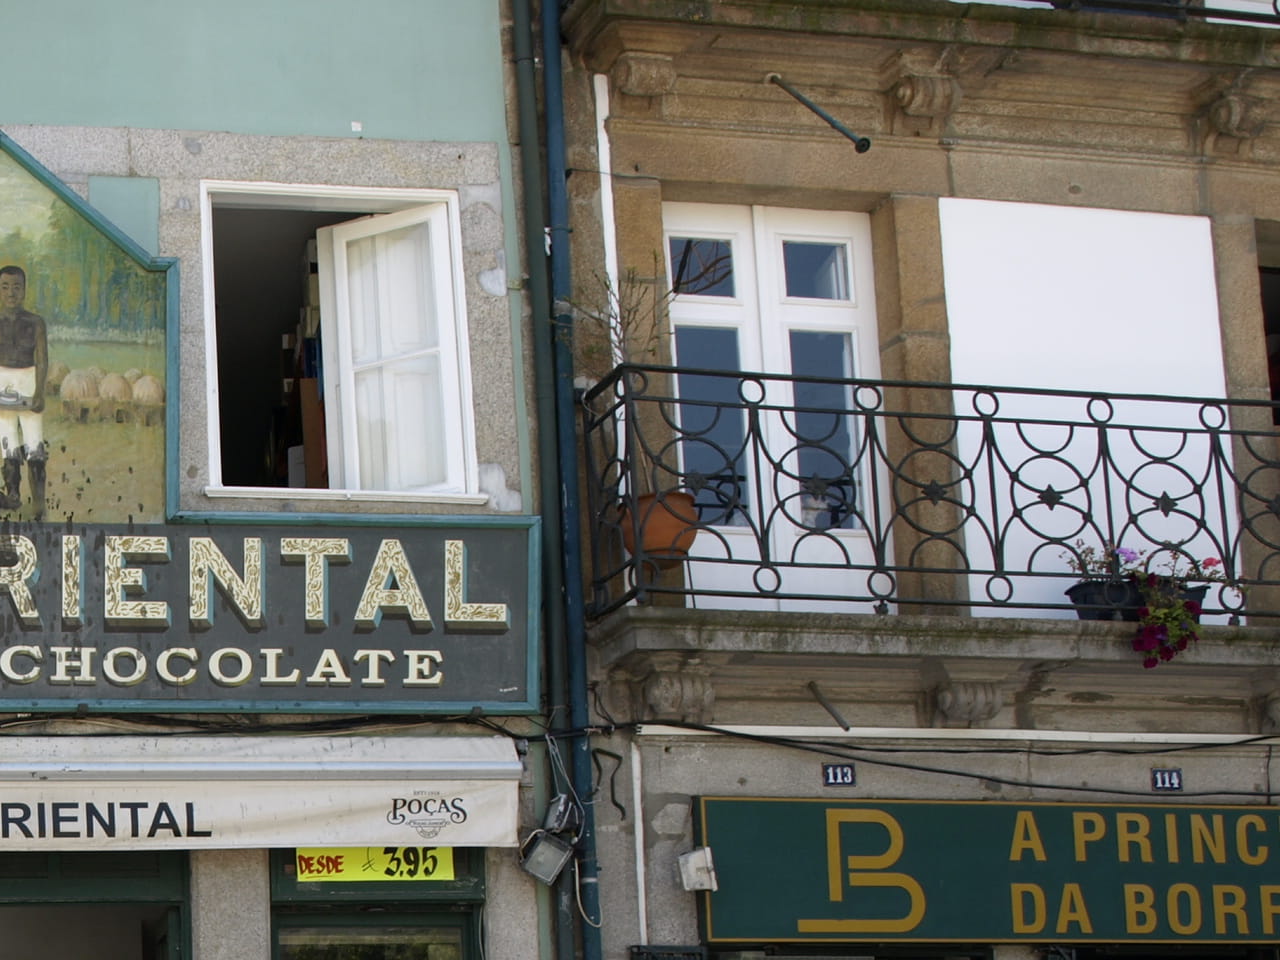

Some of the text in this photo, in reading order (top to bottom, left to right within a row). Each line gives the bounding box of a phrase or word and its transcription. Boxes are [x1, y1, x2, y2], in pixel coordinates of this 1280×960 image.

[0, 645, 444, 688] CHOCOLATE
[825, 766, 853, 784] 113
[1154, 770, 1180, 789] 114
[386, 797, 468, 824] POÇAS
[1009, 811, 1280, 867] A PRINC
[297, 855, 345, 874] DESDE
[1010, 883, 1094, 934] DA
